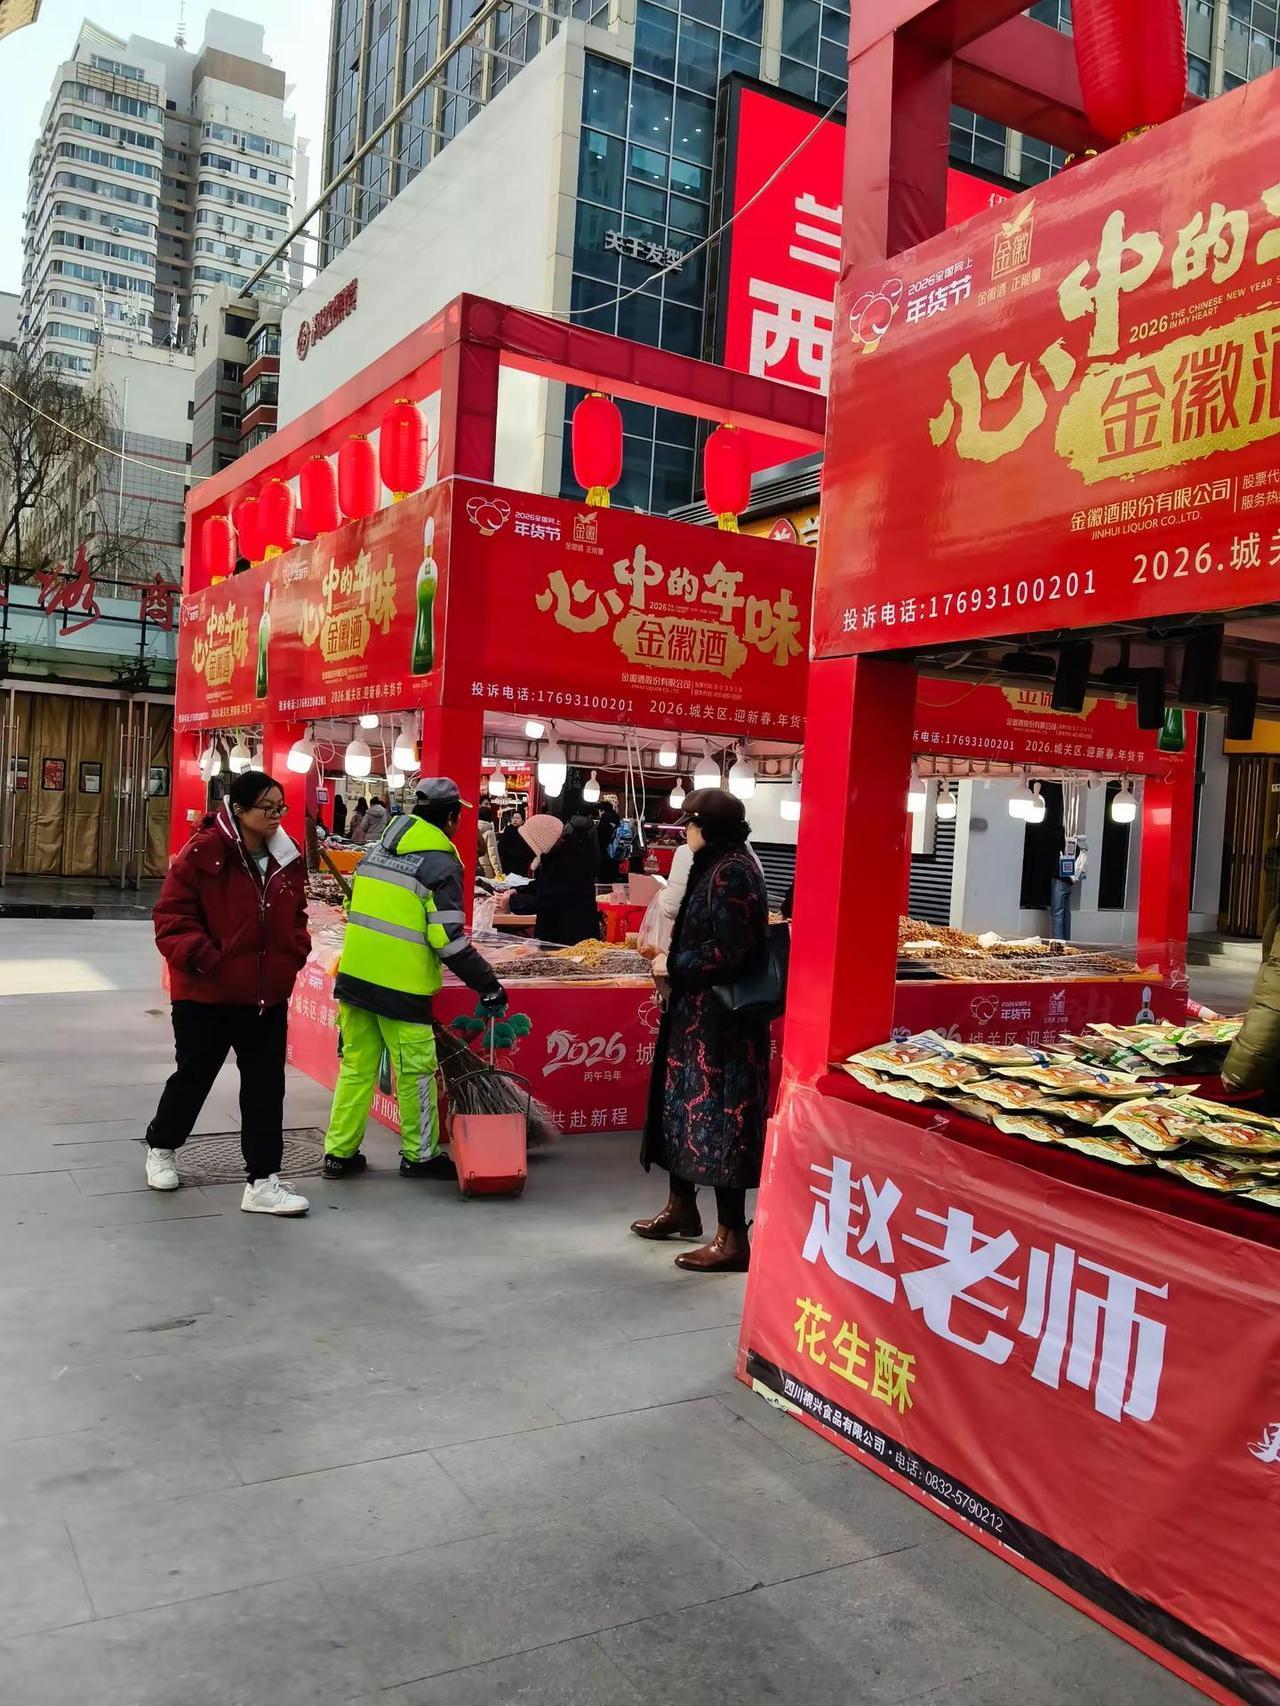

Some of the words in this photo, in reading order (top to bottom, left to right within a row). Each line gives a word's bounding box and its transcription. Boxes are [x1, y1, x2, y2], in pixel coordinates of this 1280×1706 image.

[906, 274, 972, 324] 年货节
[1170, 311, 1186, 321] THE
[1188, 296, 1223, 315] CHINESE
[1226, 287, 1247, 301] NEW
[1250, 278, 1273, 293] YEAR
[1191, 306, 1218, 322] HEART
[1128, 315, 1168, 344] 2026
[1070, 478, 1231, 532] 金徽酒股份有限公司
[514, 520, 561, 541] 年货节
[1091, 526, 1121, 541] JINHUI
[1122, 519, 1159, 535] LIQUOR
[534, 543, 805, 667] 心中的年味
[649, 601, 667, 611] 2026
[842, 568, 1097, 633] 投诉电话:17693100201
[634, 619, 729, 667] 金徽酒
[471, 681, 634, 712] 投诉电话:17693100201
[649, 699, 810, 729] 2026.城关区.迎新春.年货
[542, 1028, 627, 1078] 2026
[583, 1070, 622, 1083] 丙午马年
[801, 1155, 1169, 1423] 赵老师
[793, 1296, 917, 1415] 花生酥
